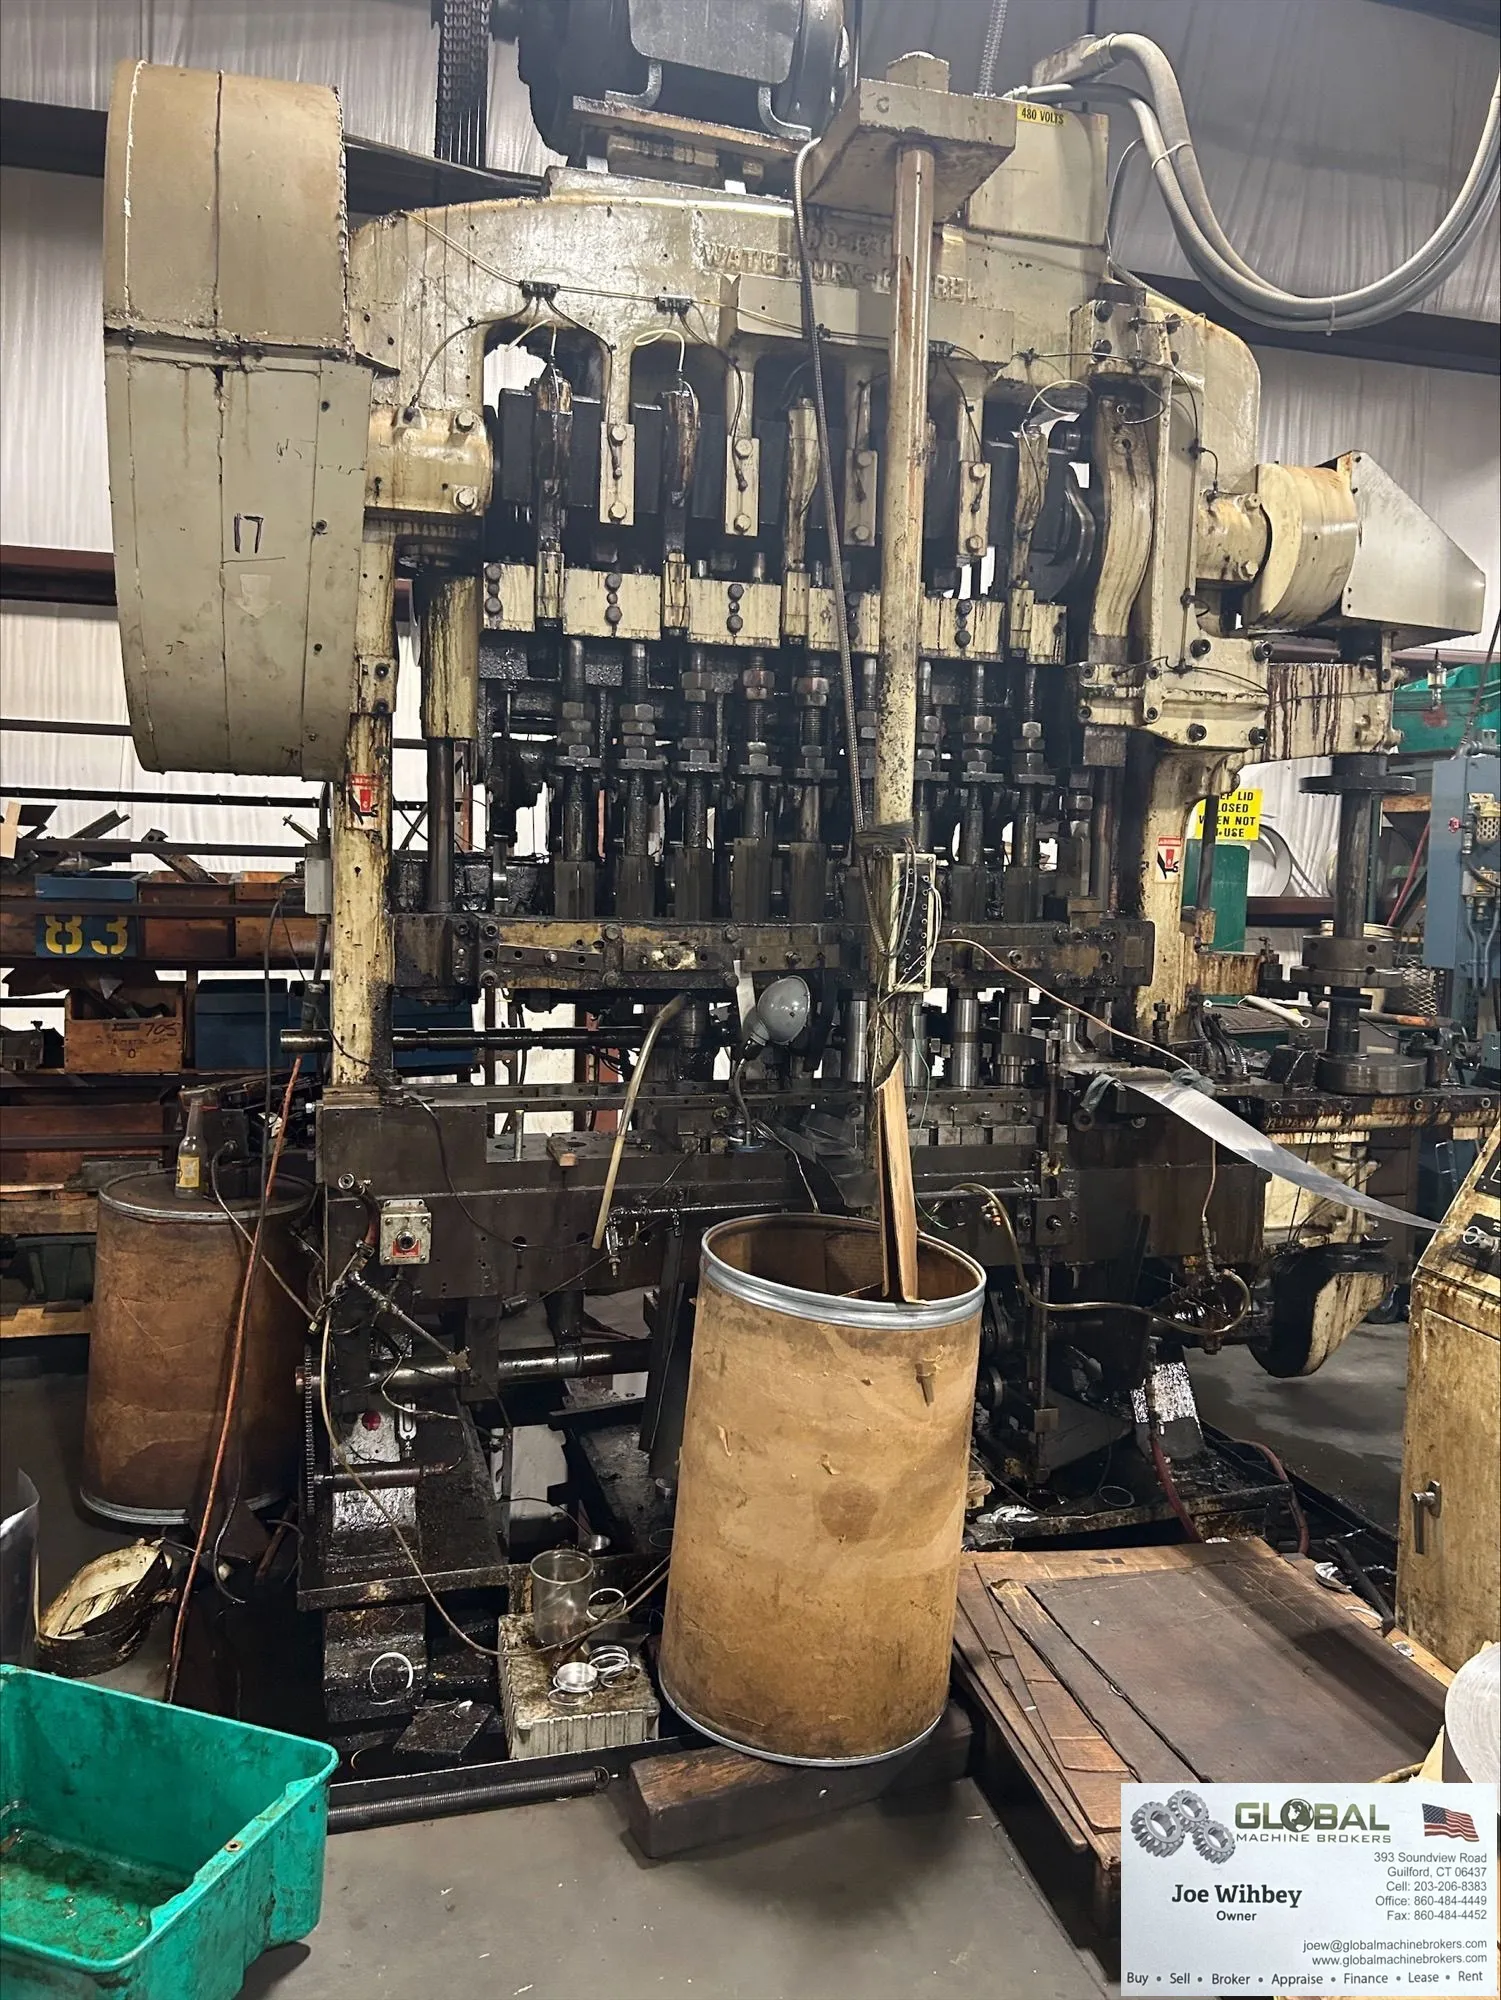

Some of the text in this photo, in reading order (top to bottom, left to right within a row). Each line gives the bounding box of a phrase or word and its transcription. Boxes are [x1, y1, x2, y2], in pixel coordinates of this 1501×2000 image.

[1021, 107, 1064, 125] 480 VOLTS
[233, 513, 264, 554] 17
[1237, 791, 1254, 801] LID
[1235, 816, 1256, 826] NOT
[1224, 828, 1245, 838] USE
